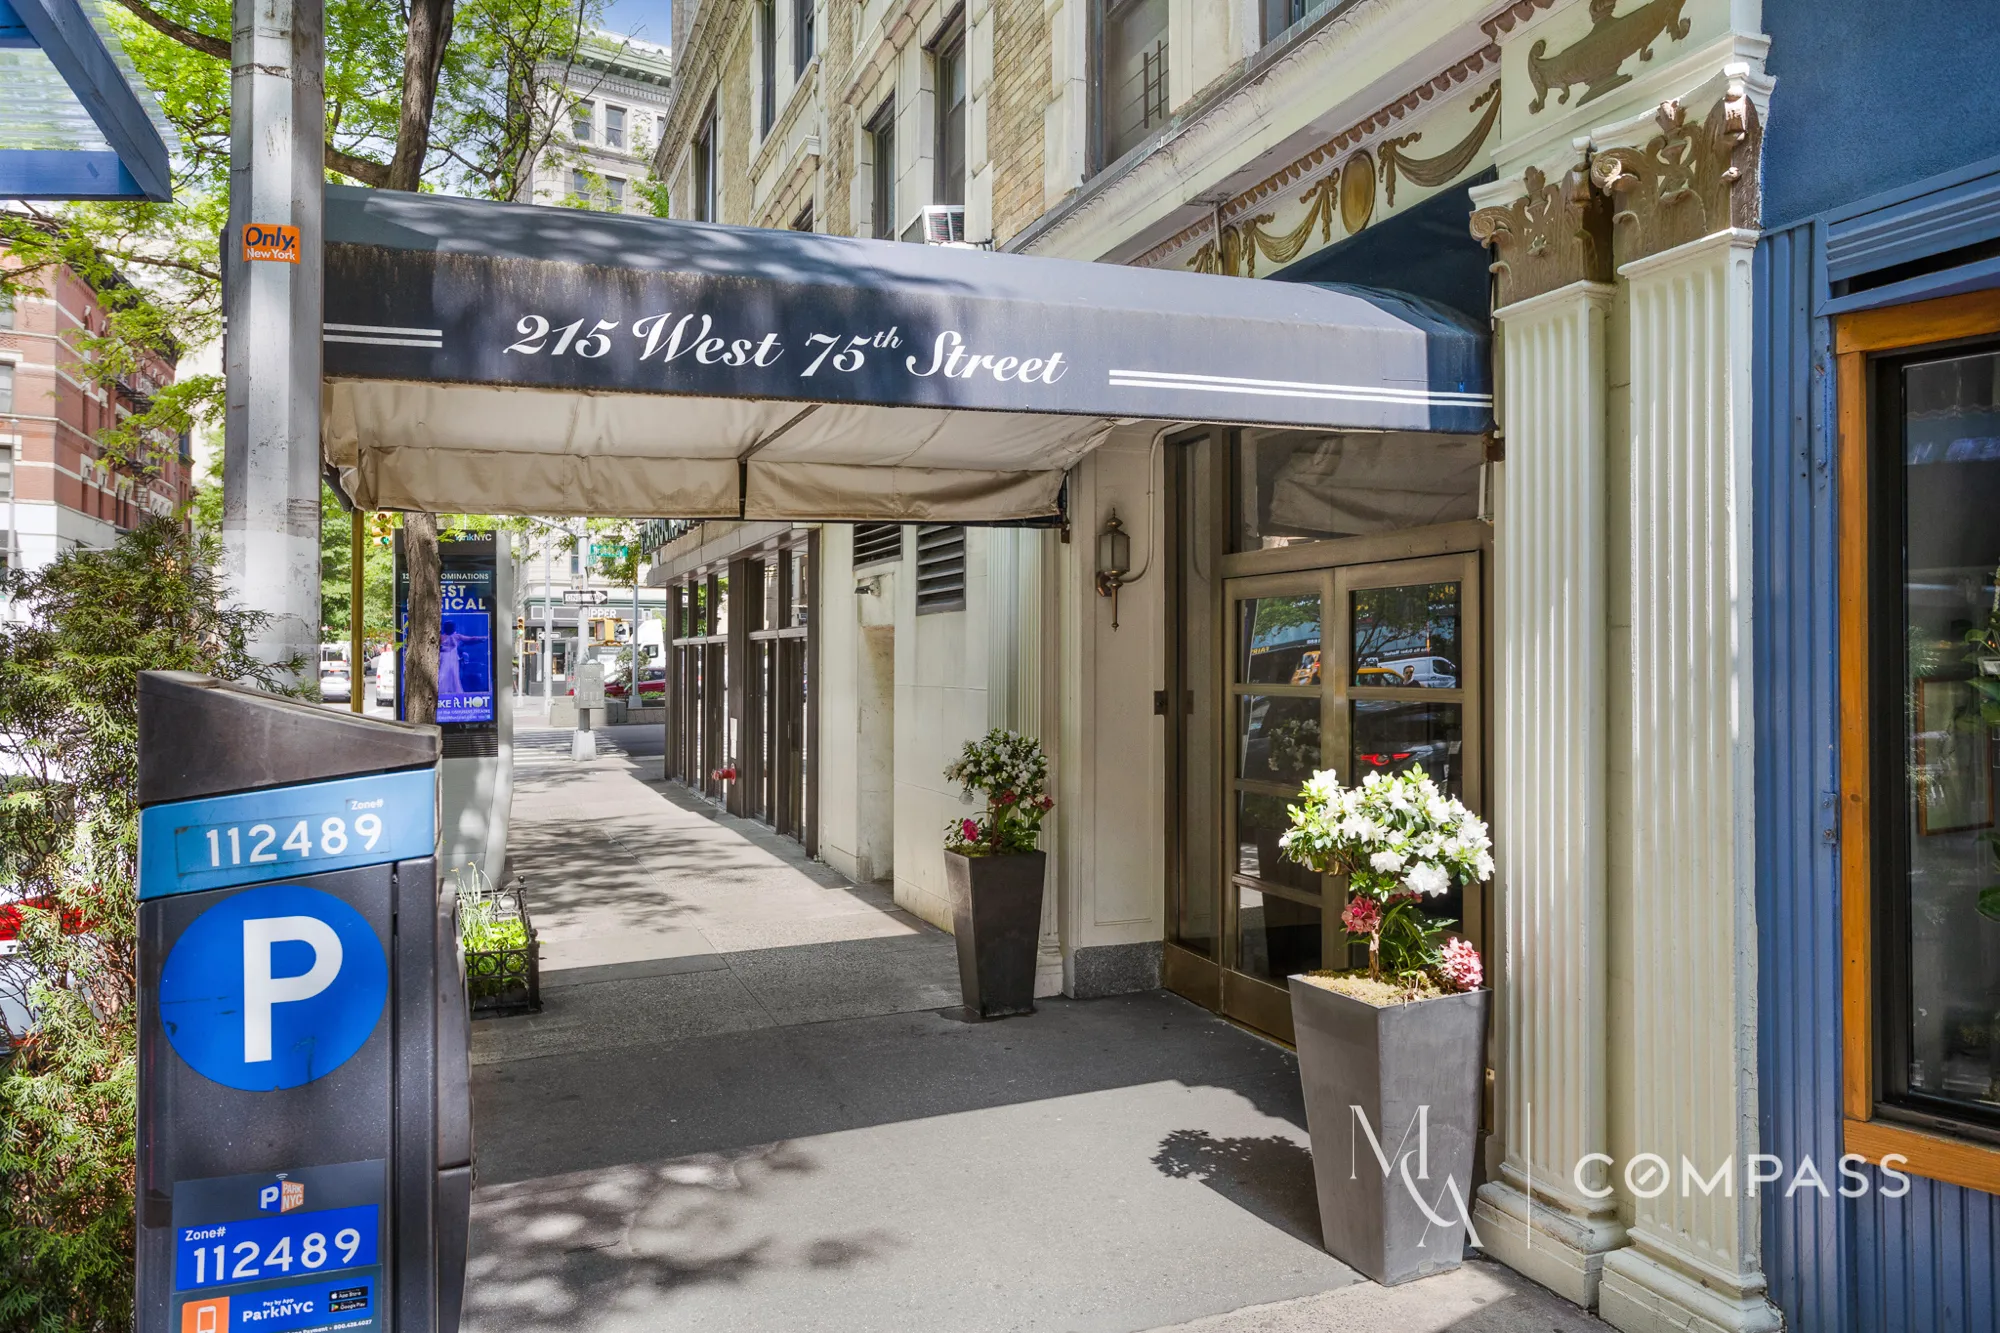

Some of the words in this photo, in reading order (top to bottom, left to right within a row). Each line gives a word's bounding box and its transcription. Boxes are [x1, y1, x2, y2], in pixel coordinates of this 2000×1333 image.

[245, 226, 295, 251] Only.
[247, 248, 271, 259] New
[271, 248, 296, 260] York
[503, 313, 620, 358] 215
[632, 312, 785, 368] West
[800, 325, 904, 378] 75th
[906, 329, 1069, 385] Street
[440, 585, 466, 597] EST
[463, 696, 490, 708] HOT
[351, 798, 384, 811] Zone#
[206, 813, 383, 867] 112489
[243, 915, 344, 1064] P
[260, 1186, 279, 1209] P
[281, 1182, 304, 1195] PARK
[281, 1194, 304, 1210] NYC
[185, 1226, 227, 1242] Zone#
[194, 1228, 361, 1284] 112489
[242, 1301, 314, 1322] ParkNYC
